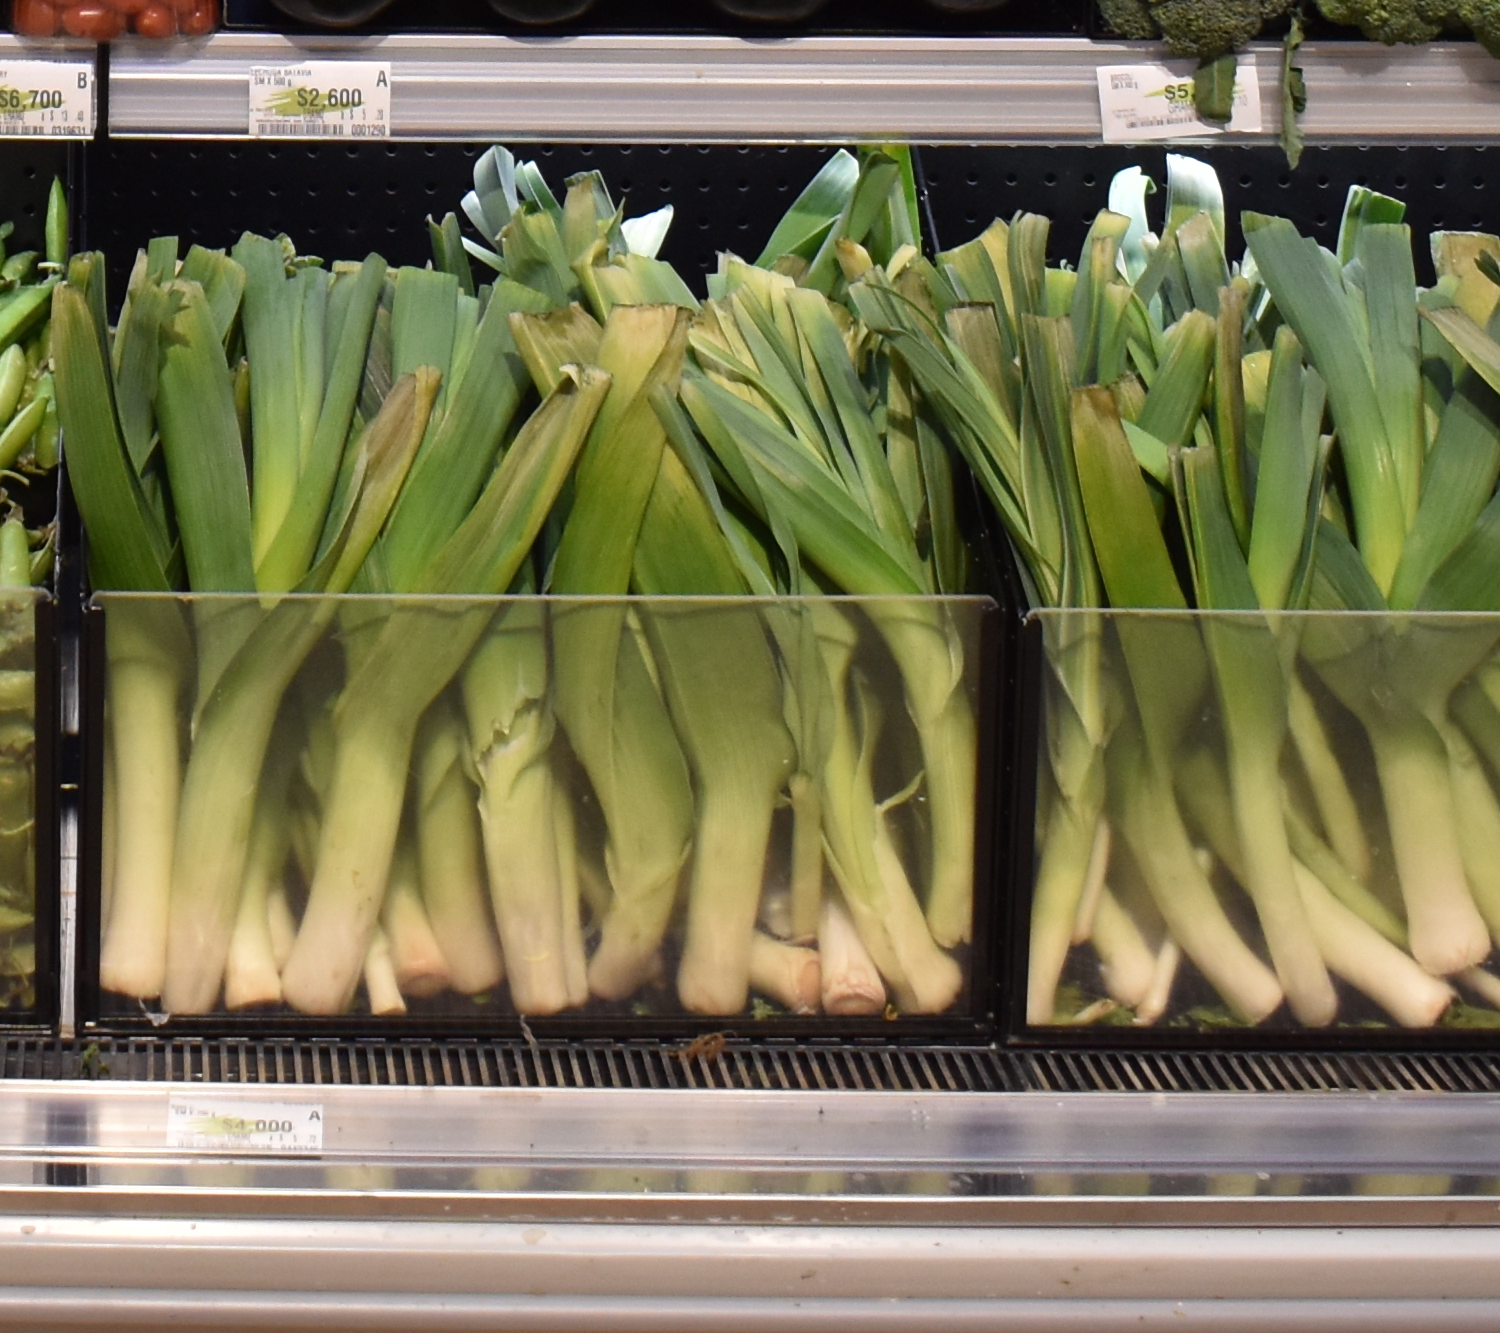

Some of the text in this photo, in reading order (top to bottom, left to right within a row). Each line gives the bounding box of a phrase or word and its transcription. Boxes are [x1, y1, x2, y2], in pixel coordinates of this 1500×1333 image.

[77, 72, 87, 88] B
[376, 70, 387, 87] A
[297, 88, 361, 107] $2,600
[308, 1110, 320, 1121] A
[222, 1119, 292, 1132] $4,000
